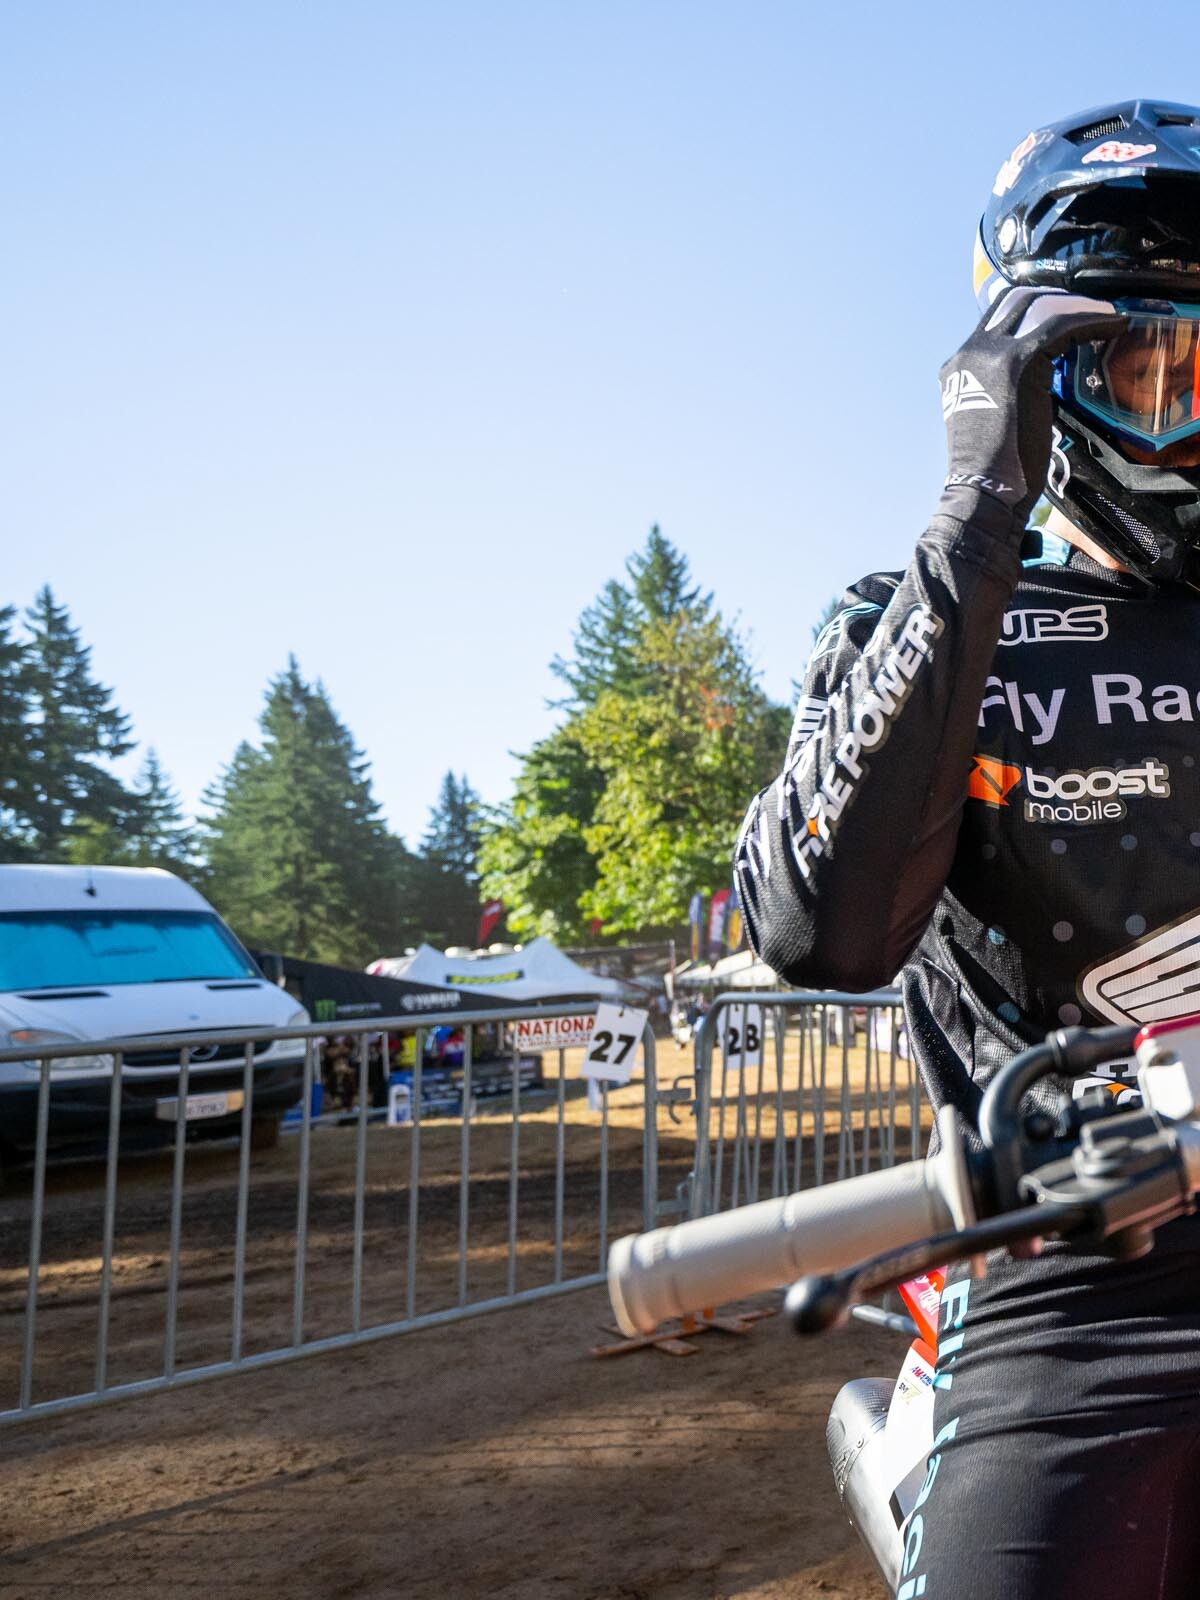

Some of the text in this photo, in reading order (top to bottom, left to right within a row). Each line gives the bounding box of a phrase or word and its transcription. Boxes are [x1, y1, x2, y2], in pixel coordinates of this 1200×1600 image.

[1025, 762, 1166, 800] boost
[1029, 801, 1122, 822] mobile
[517, 1015, 595, 1037] NATIONA
[727, 1023, 760, 1056] 28
[589, 1030, 636, 1065] 27
